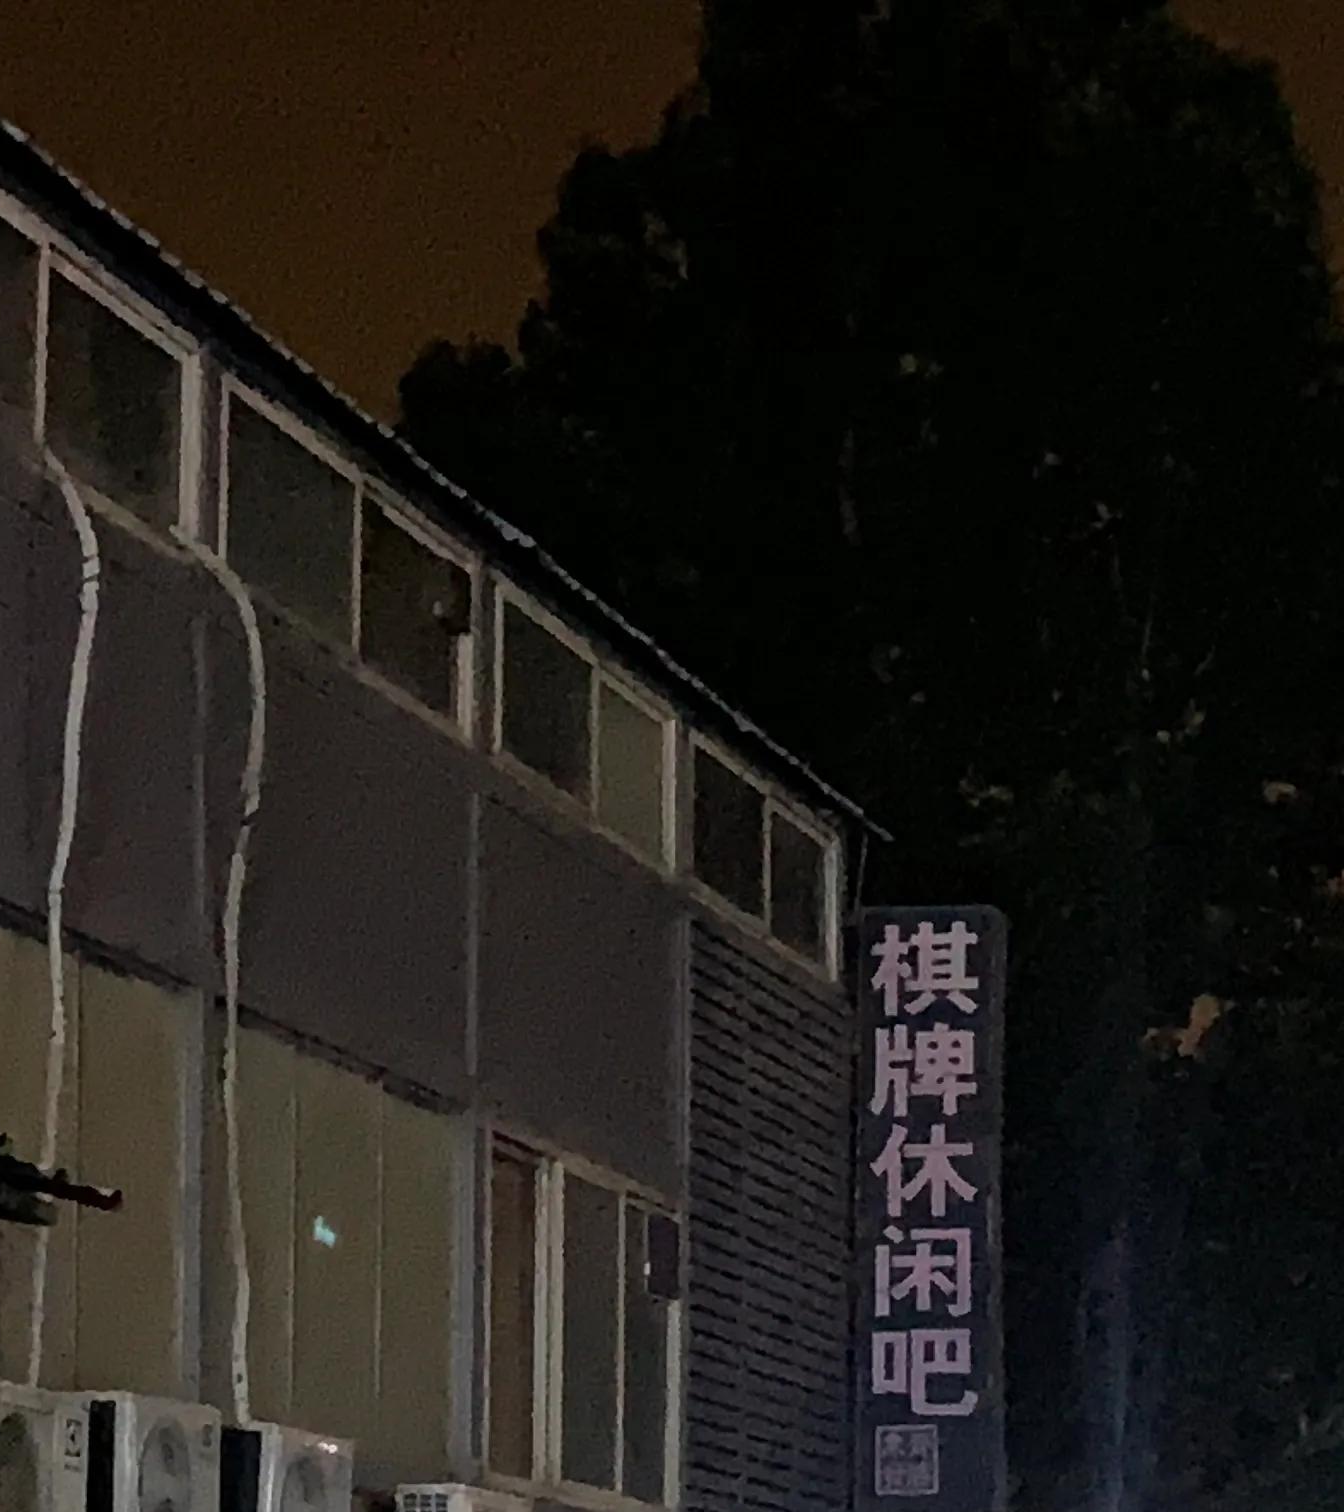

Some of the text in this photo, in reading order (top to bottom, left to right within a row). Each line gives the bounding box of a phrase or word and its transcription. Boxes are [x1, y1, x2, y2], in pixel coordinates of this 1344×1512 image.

[869, 921, 979, 1416] 棋牌休闲吧
